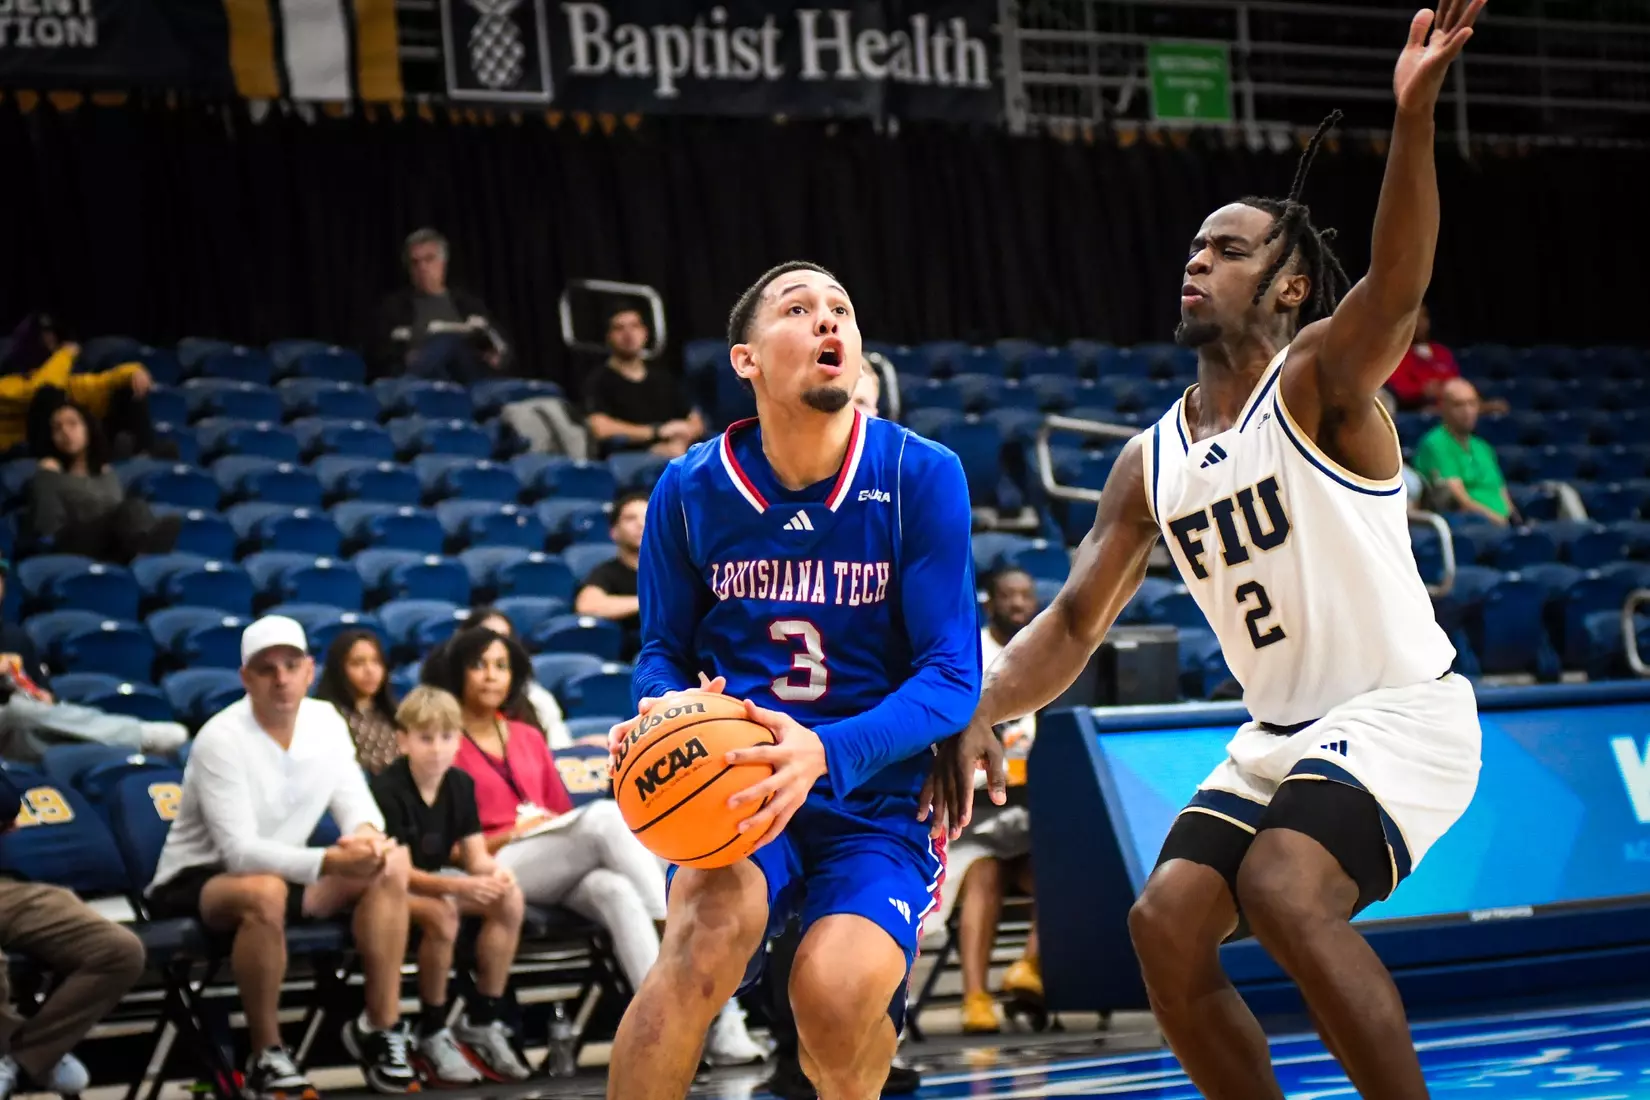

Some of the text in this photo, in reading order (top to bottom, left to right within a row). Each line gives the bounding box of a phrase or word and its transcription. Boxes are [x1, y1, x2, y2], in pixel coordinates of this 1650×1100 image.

[561, 2, 992, 97] Baptist Health
[1166, 474, 1292, 581] FIU
[711, 559, 890, 607] LOUISIANA TECH
[1235, 580, 1287, 649] 2
[769, 619, 829, 701] 3
[634, 737, 709, 802] NCAA
